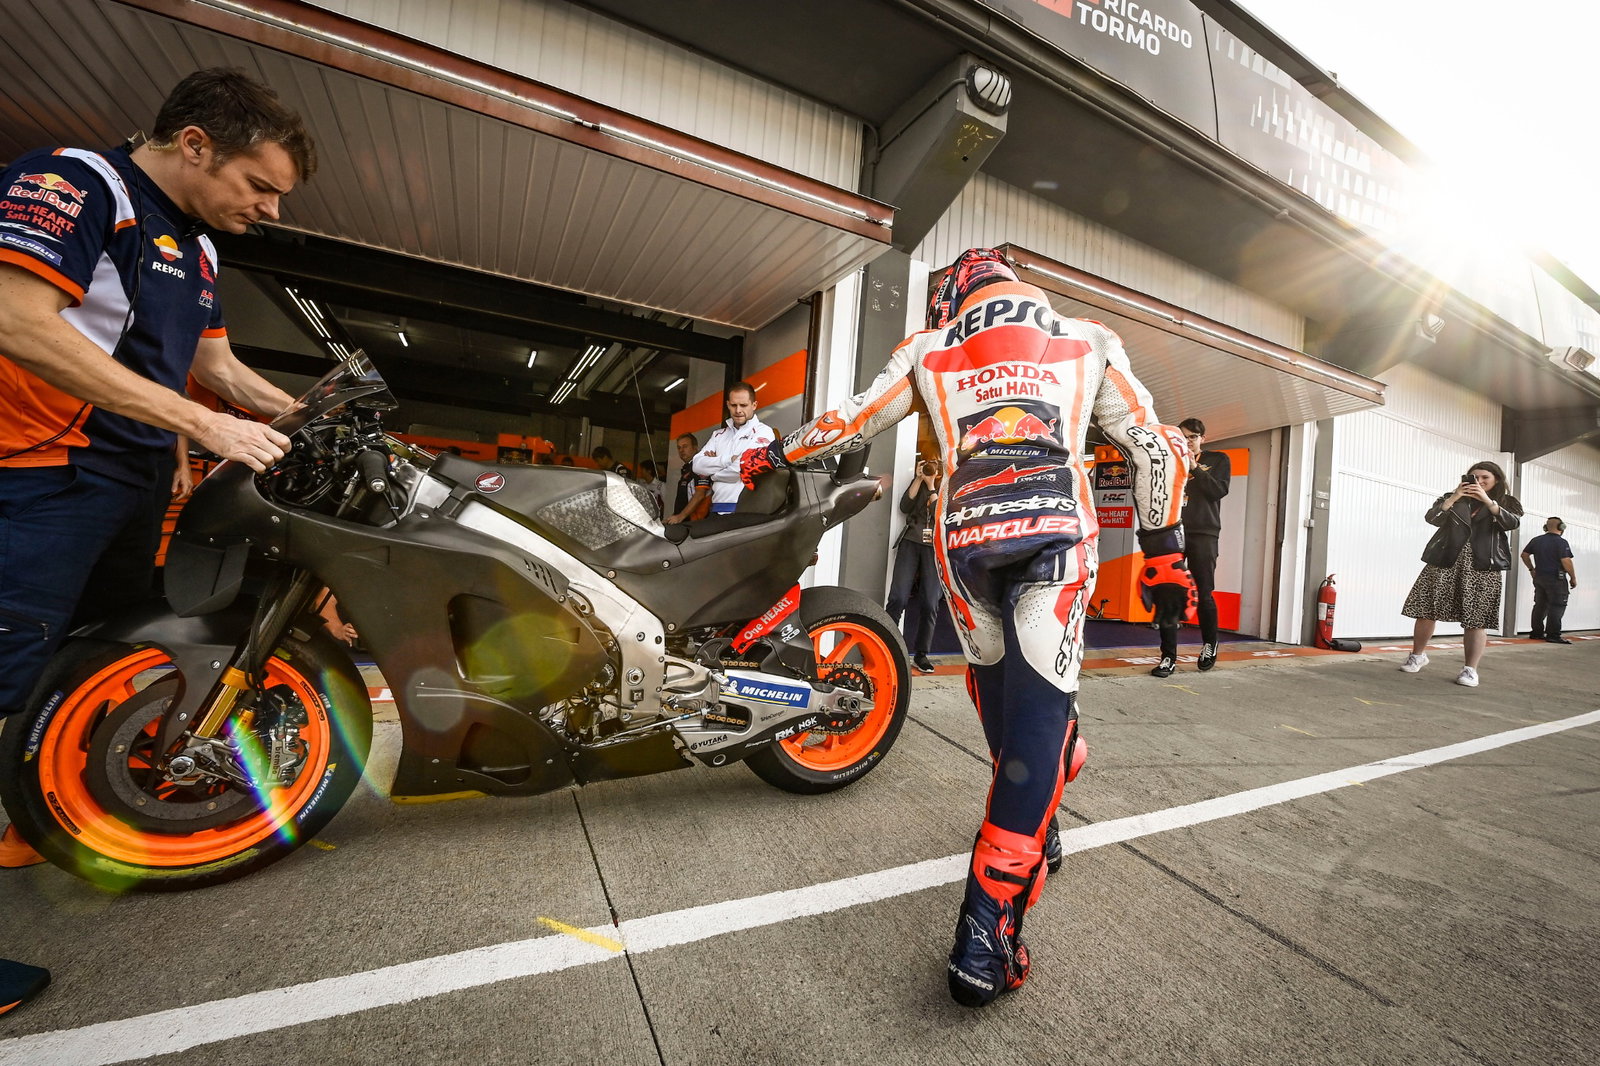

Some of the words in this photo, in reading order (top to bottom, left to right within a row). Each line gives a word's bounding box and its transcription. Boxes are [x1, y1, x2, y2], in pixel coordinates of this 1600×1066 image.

[1076, 1, 1160, 56] TORMO
[1104, 0, 1193, 49] RICARDO
[5, 210, 30, 221] Satu
[7, 185, 46, 201] Red
[42, 190, 82, 218] Bull
[0, 200, 26, 211] One
[28, 204, 76, 233] HEART.
[4, 236, 56, 260] MICHELIN
[944, 299, 1069, 348] REPSOL
[957, 364, 1061, 392] HONDA
[975, 386, 1002, 403] Satu
[990, 448, 1041, 456] MICHELIN
[1099, 477, 1114, 487] Red
[1114, 476, 1131, 487] Bull
[1126, 425, 1168, 527] alpinestars
[944, 495, 1077, 527] alpinestars
[948, 515, 1081, 549] MARQUEZ
[743, 623, 764, 640] One
[760, 597, 793, 625] HEART.
[740, 685, 803, 702] MICHELIN
[29, 693, 61, 743] MICHELIN
[798, 716, 819, 731] NGK
[698, 734, 729, 748] YUTAKA
[775, 725, 796, 741] RK
[272, 746, 281, 775] brembo
[833, 760, 868, 780] MICHELIN
[299, 777, 329, 820] MICHELIN
